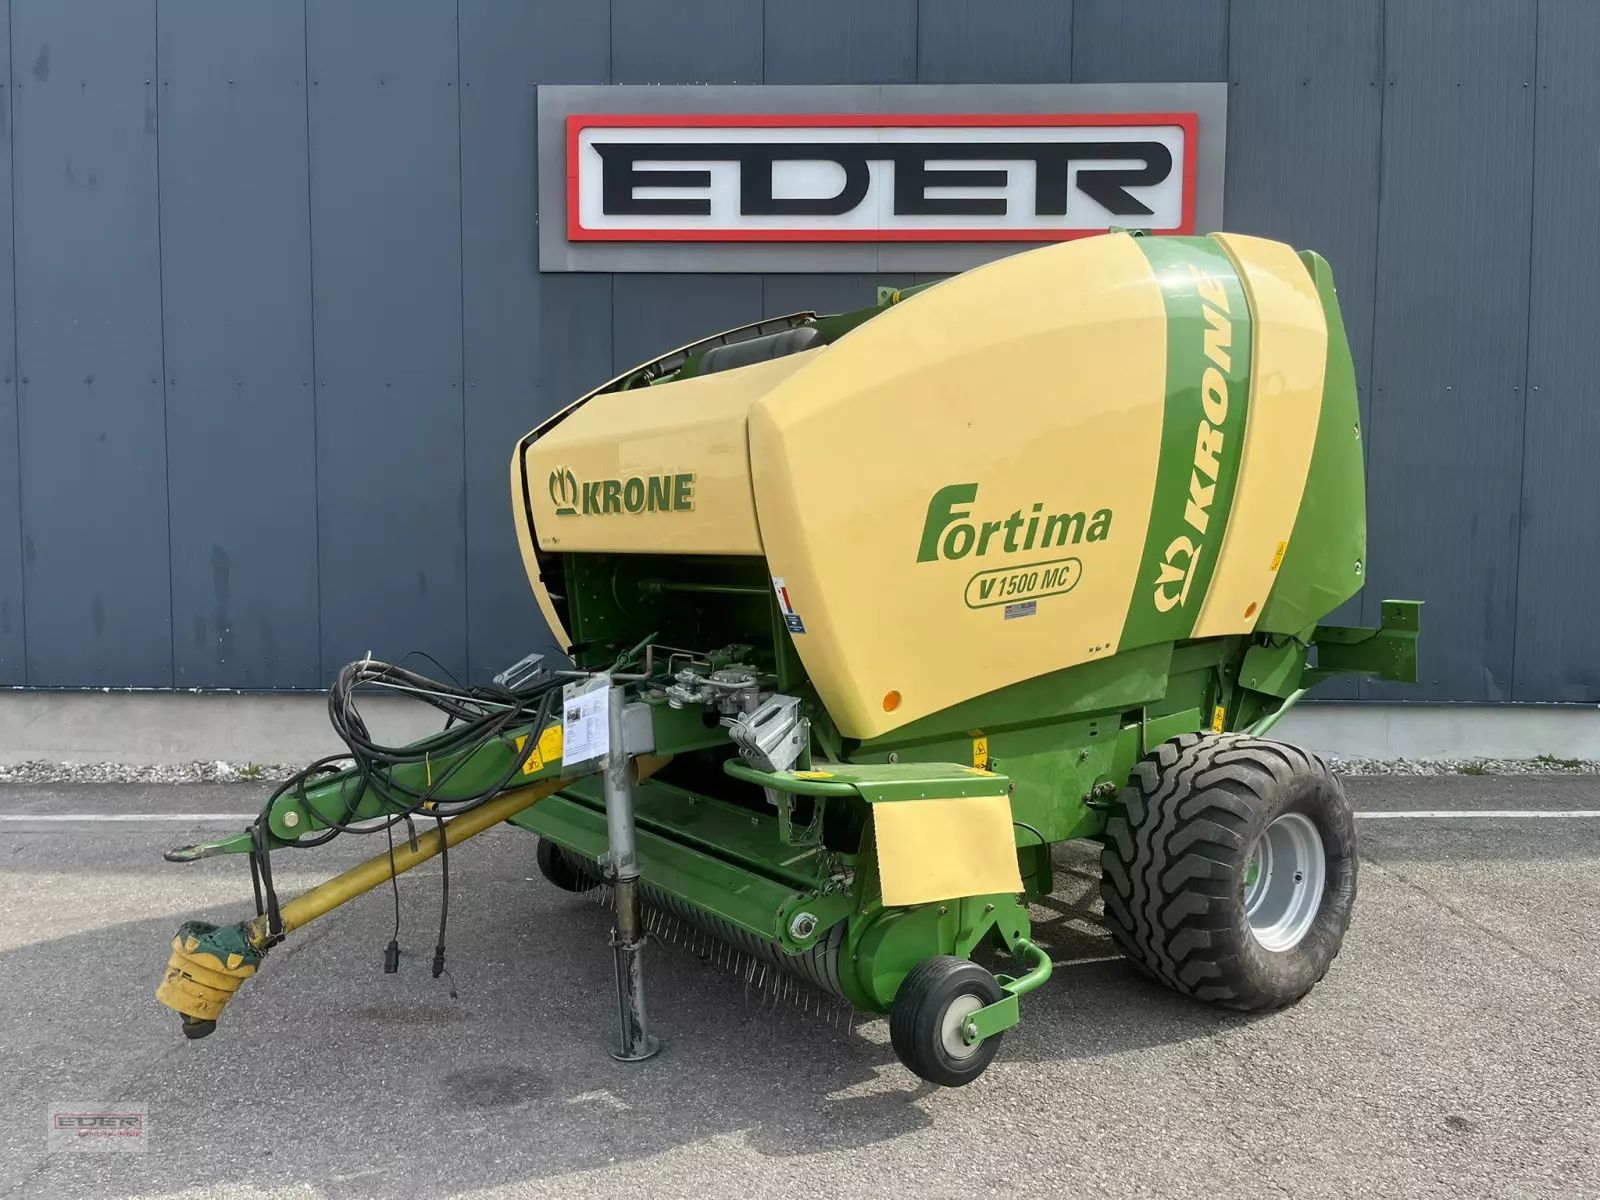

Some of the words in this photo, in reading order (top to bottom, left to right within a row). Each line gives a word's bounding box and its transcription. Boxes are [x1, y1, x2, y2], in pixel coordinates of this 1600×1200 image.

[590, 142, 1173, 216] EDER
[1184, 264, 1232, 535] KRONE
[582, 473, 693, 516] KRONE
[916, 482, 1113, 563] Fortima
[979, 578, 997, 600] V
[998, 573, 1038, 597] 1500
[1040, 566, 1070, 590] MC
